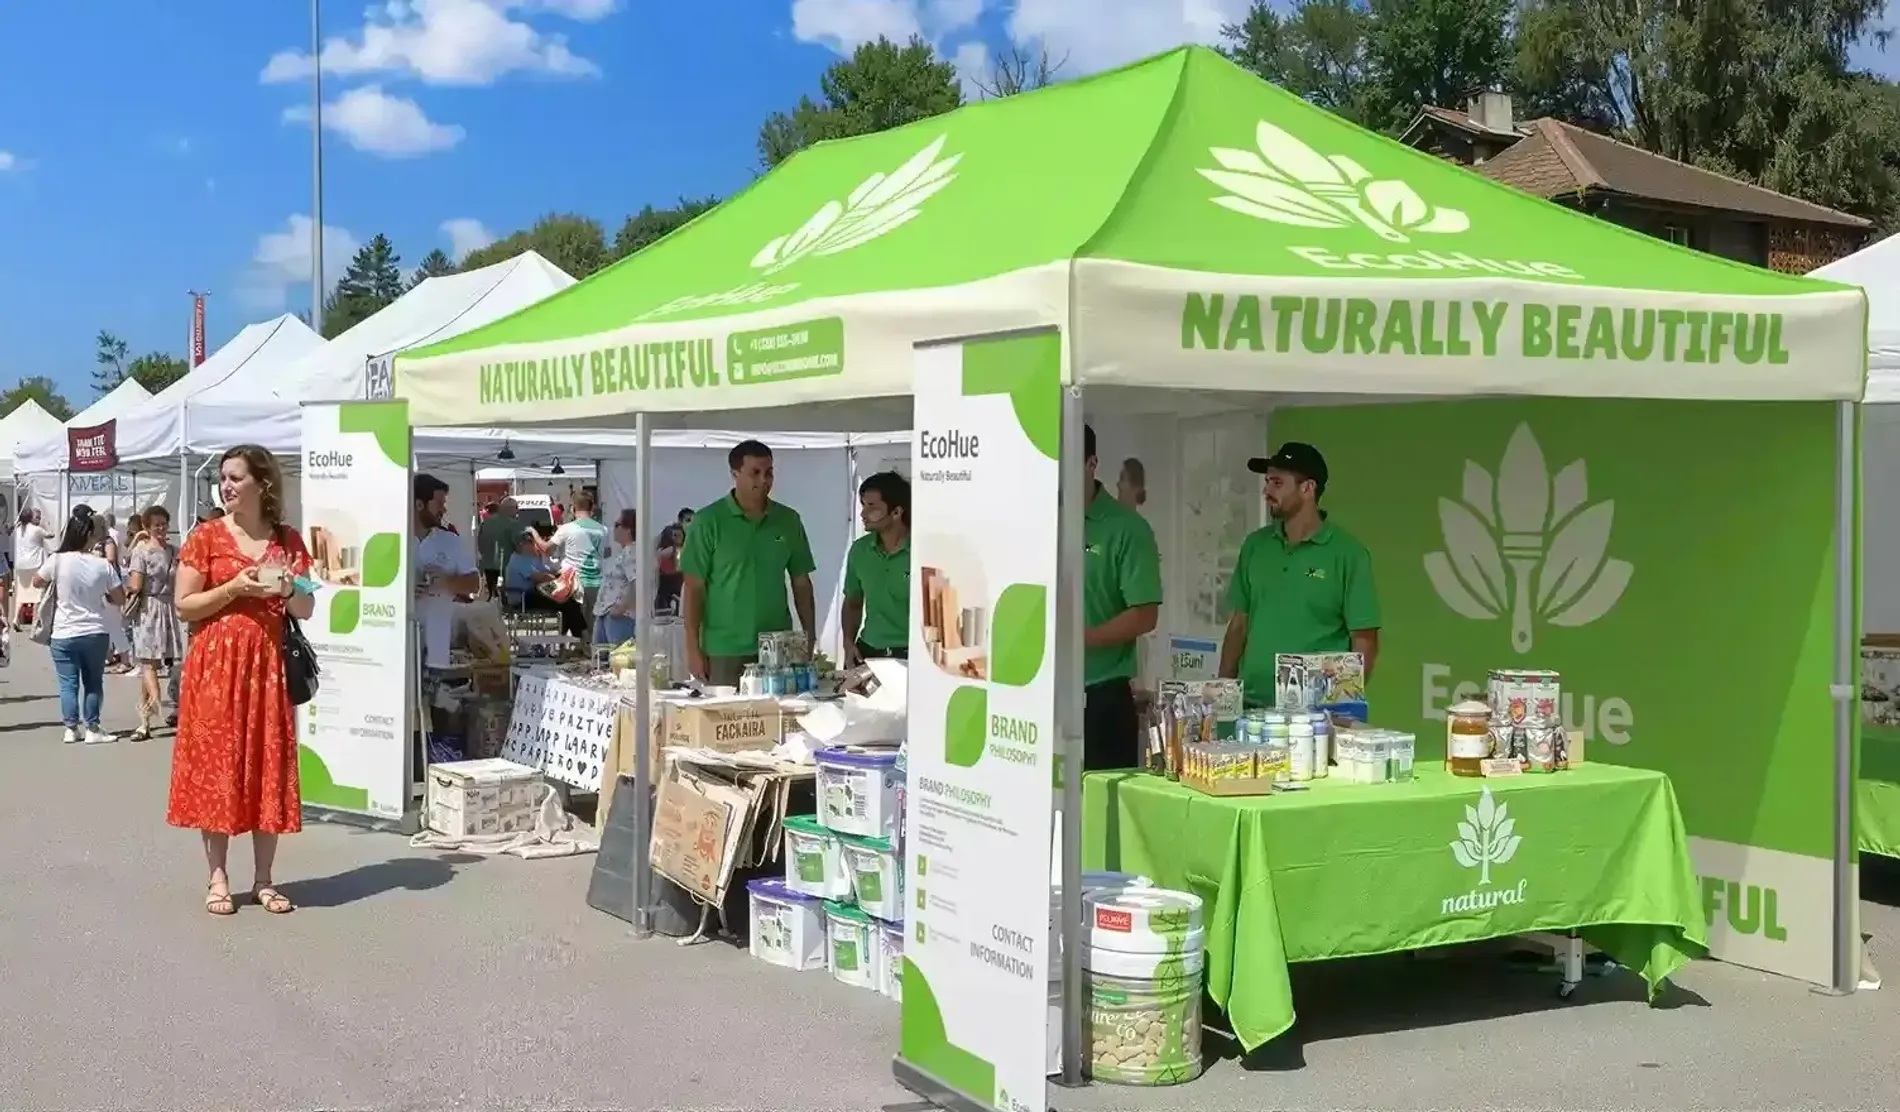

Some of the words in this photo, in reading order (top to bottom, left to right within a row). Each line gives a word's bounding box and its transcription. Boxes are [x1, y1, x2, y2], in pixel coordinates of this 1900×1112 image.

[1285, 245, 1586, 279] EcoHue
[1181, 291, 1509, 358] NATURALLY
[1522, 301, 1790, 365] BEAUTIFUL
[480, 353, 586, 405] NATURALLY
[590, 338, 720, 395] BEAUTIFUL
[309, 449, 353, 468] EcoHue
[920, 429, 980, 459] EcoHue
[920, 470, 945, 483] Naturally
[946, 470, 972, 482] Beautiful
[362, 602, 396, 619] BRAND
[991, 714, 1038, 745] BRAND
[919, 776, 944, 797] BRAND
[1441, 878, 1528, 915] natural
[991, 923, 1034, 955] CONTACT
[970, 941, 1034, 982] INFORMATION
